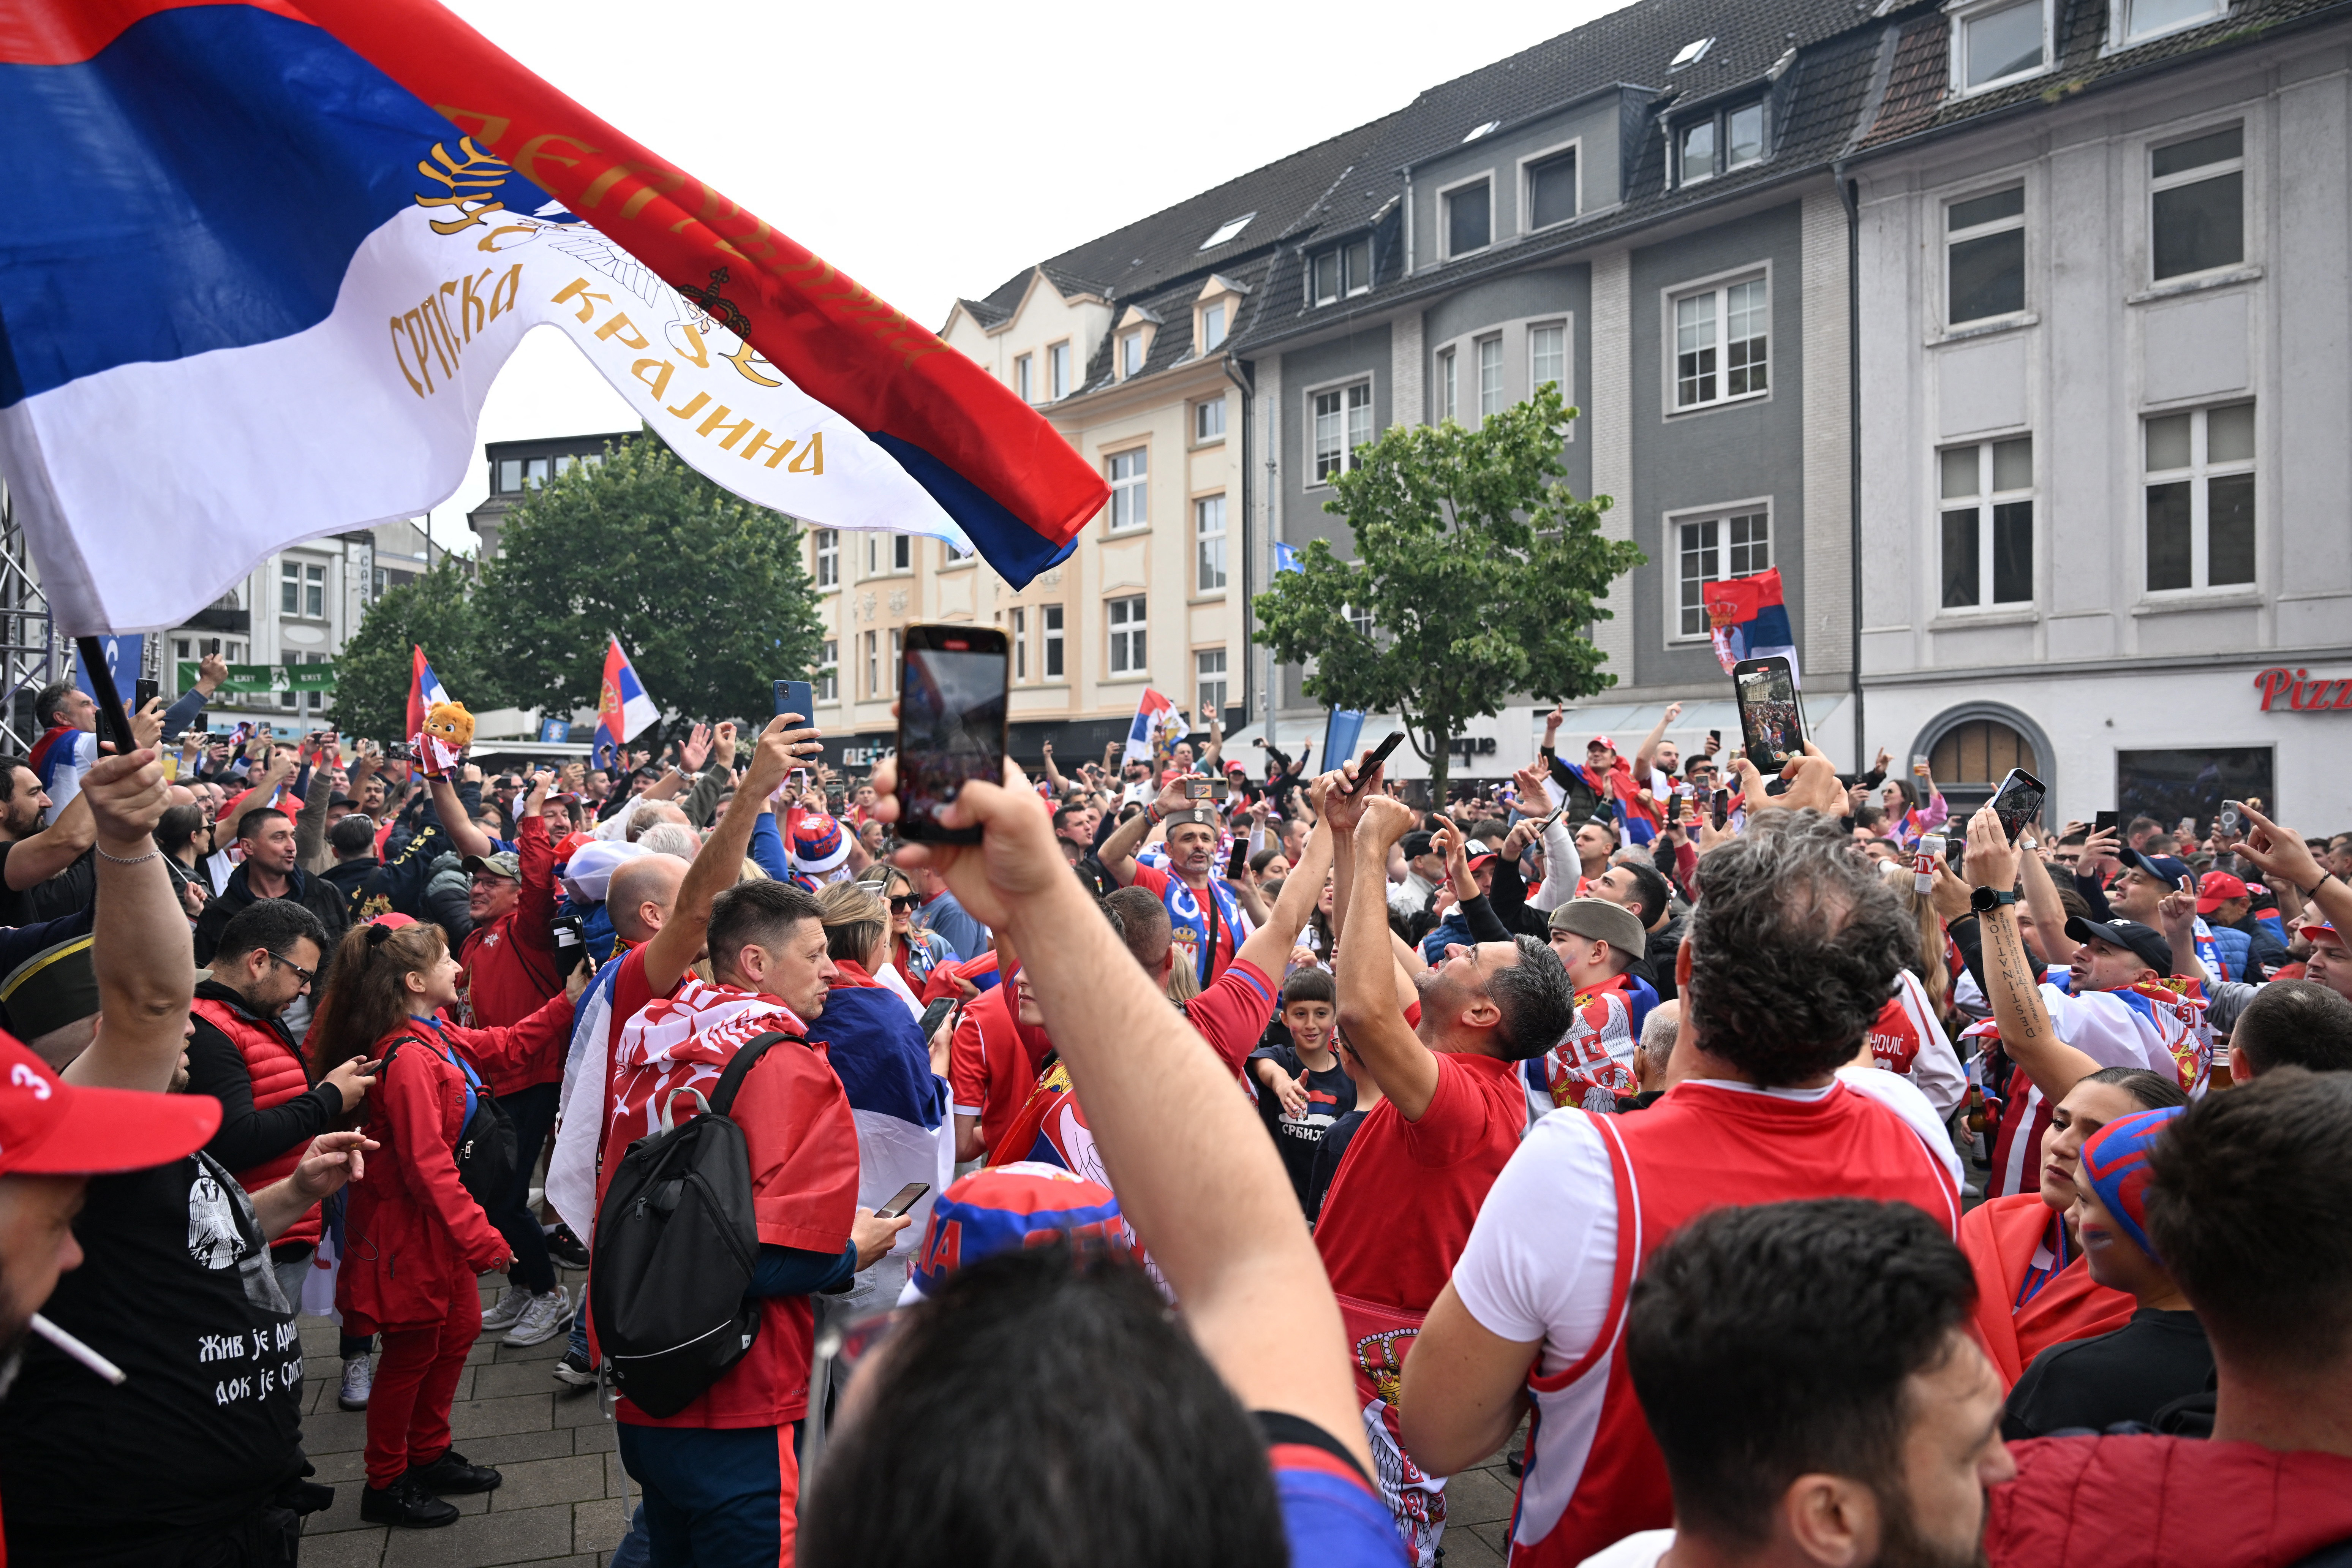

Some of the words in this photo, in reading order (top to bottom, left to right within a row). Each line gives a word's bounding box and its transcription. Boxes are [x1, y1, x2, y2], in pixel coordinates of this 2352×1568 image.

[390, 263, 523, 400] СРПСКА
[552, 277, 825, 476] КРАЈИНА
[234, 674, 256, 683] EXIT
[300, 673, 322, 681] EXIT
[1425, 730, 1496, 767] Uique
[1999, 912, 2007, 933] something
[2005, 935, 2013, 947] which
[1986, 914, 2036, 1038] DESTINATION
[1282, 1123, 1325, 1141] СРБИЈ
[252, 1328, 269, 1361] је
[258, 1368, 274, 1401] је
